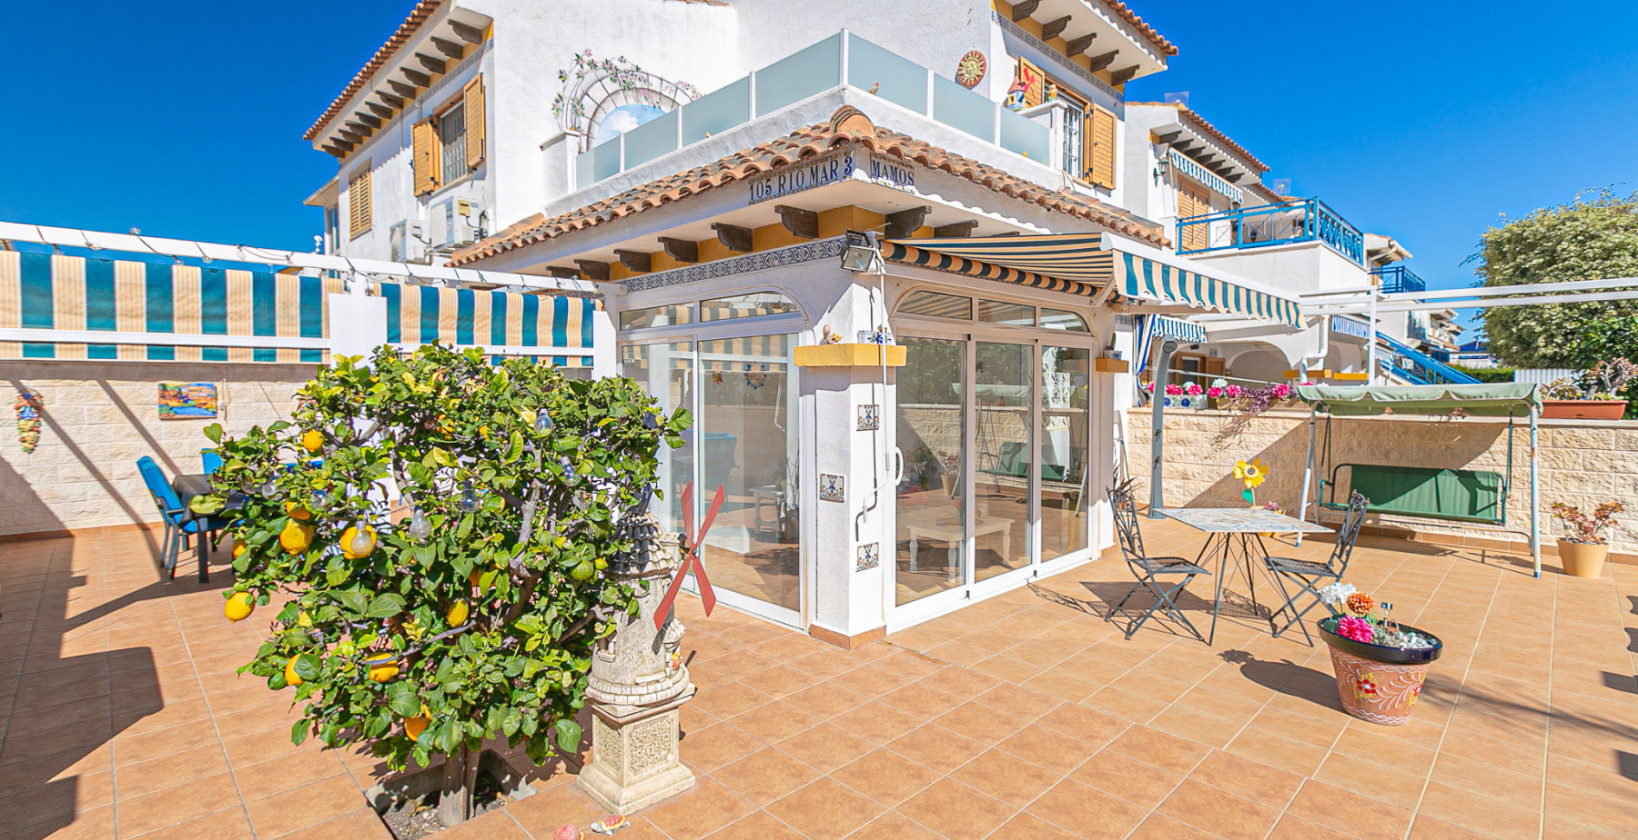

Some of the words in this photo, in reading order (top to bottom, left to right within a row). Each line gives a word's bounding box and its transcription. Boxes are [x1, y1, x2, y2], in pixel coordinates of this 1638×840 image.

[749, 178, 772, 200] 105
[778, 169, 805, 193] RIO
[810, 160, 839, 185] MAR
[844, 156, 853, 175] 3
[871, 160, 915, 186] MAMOS
